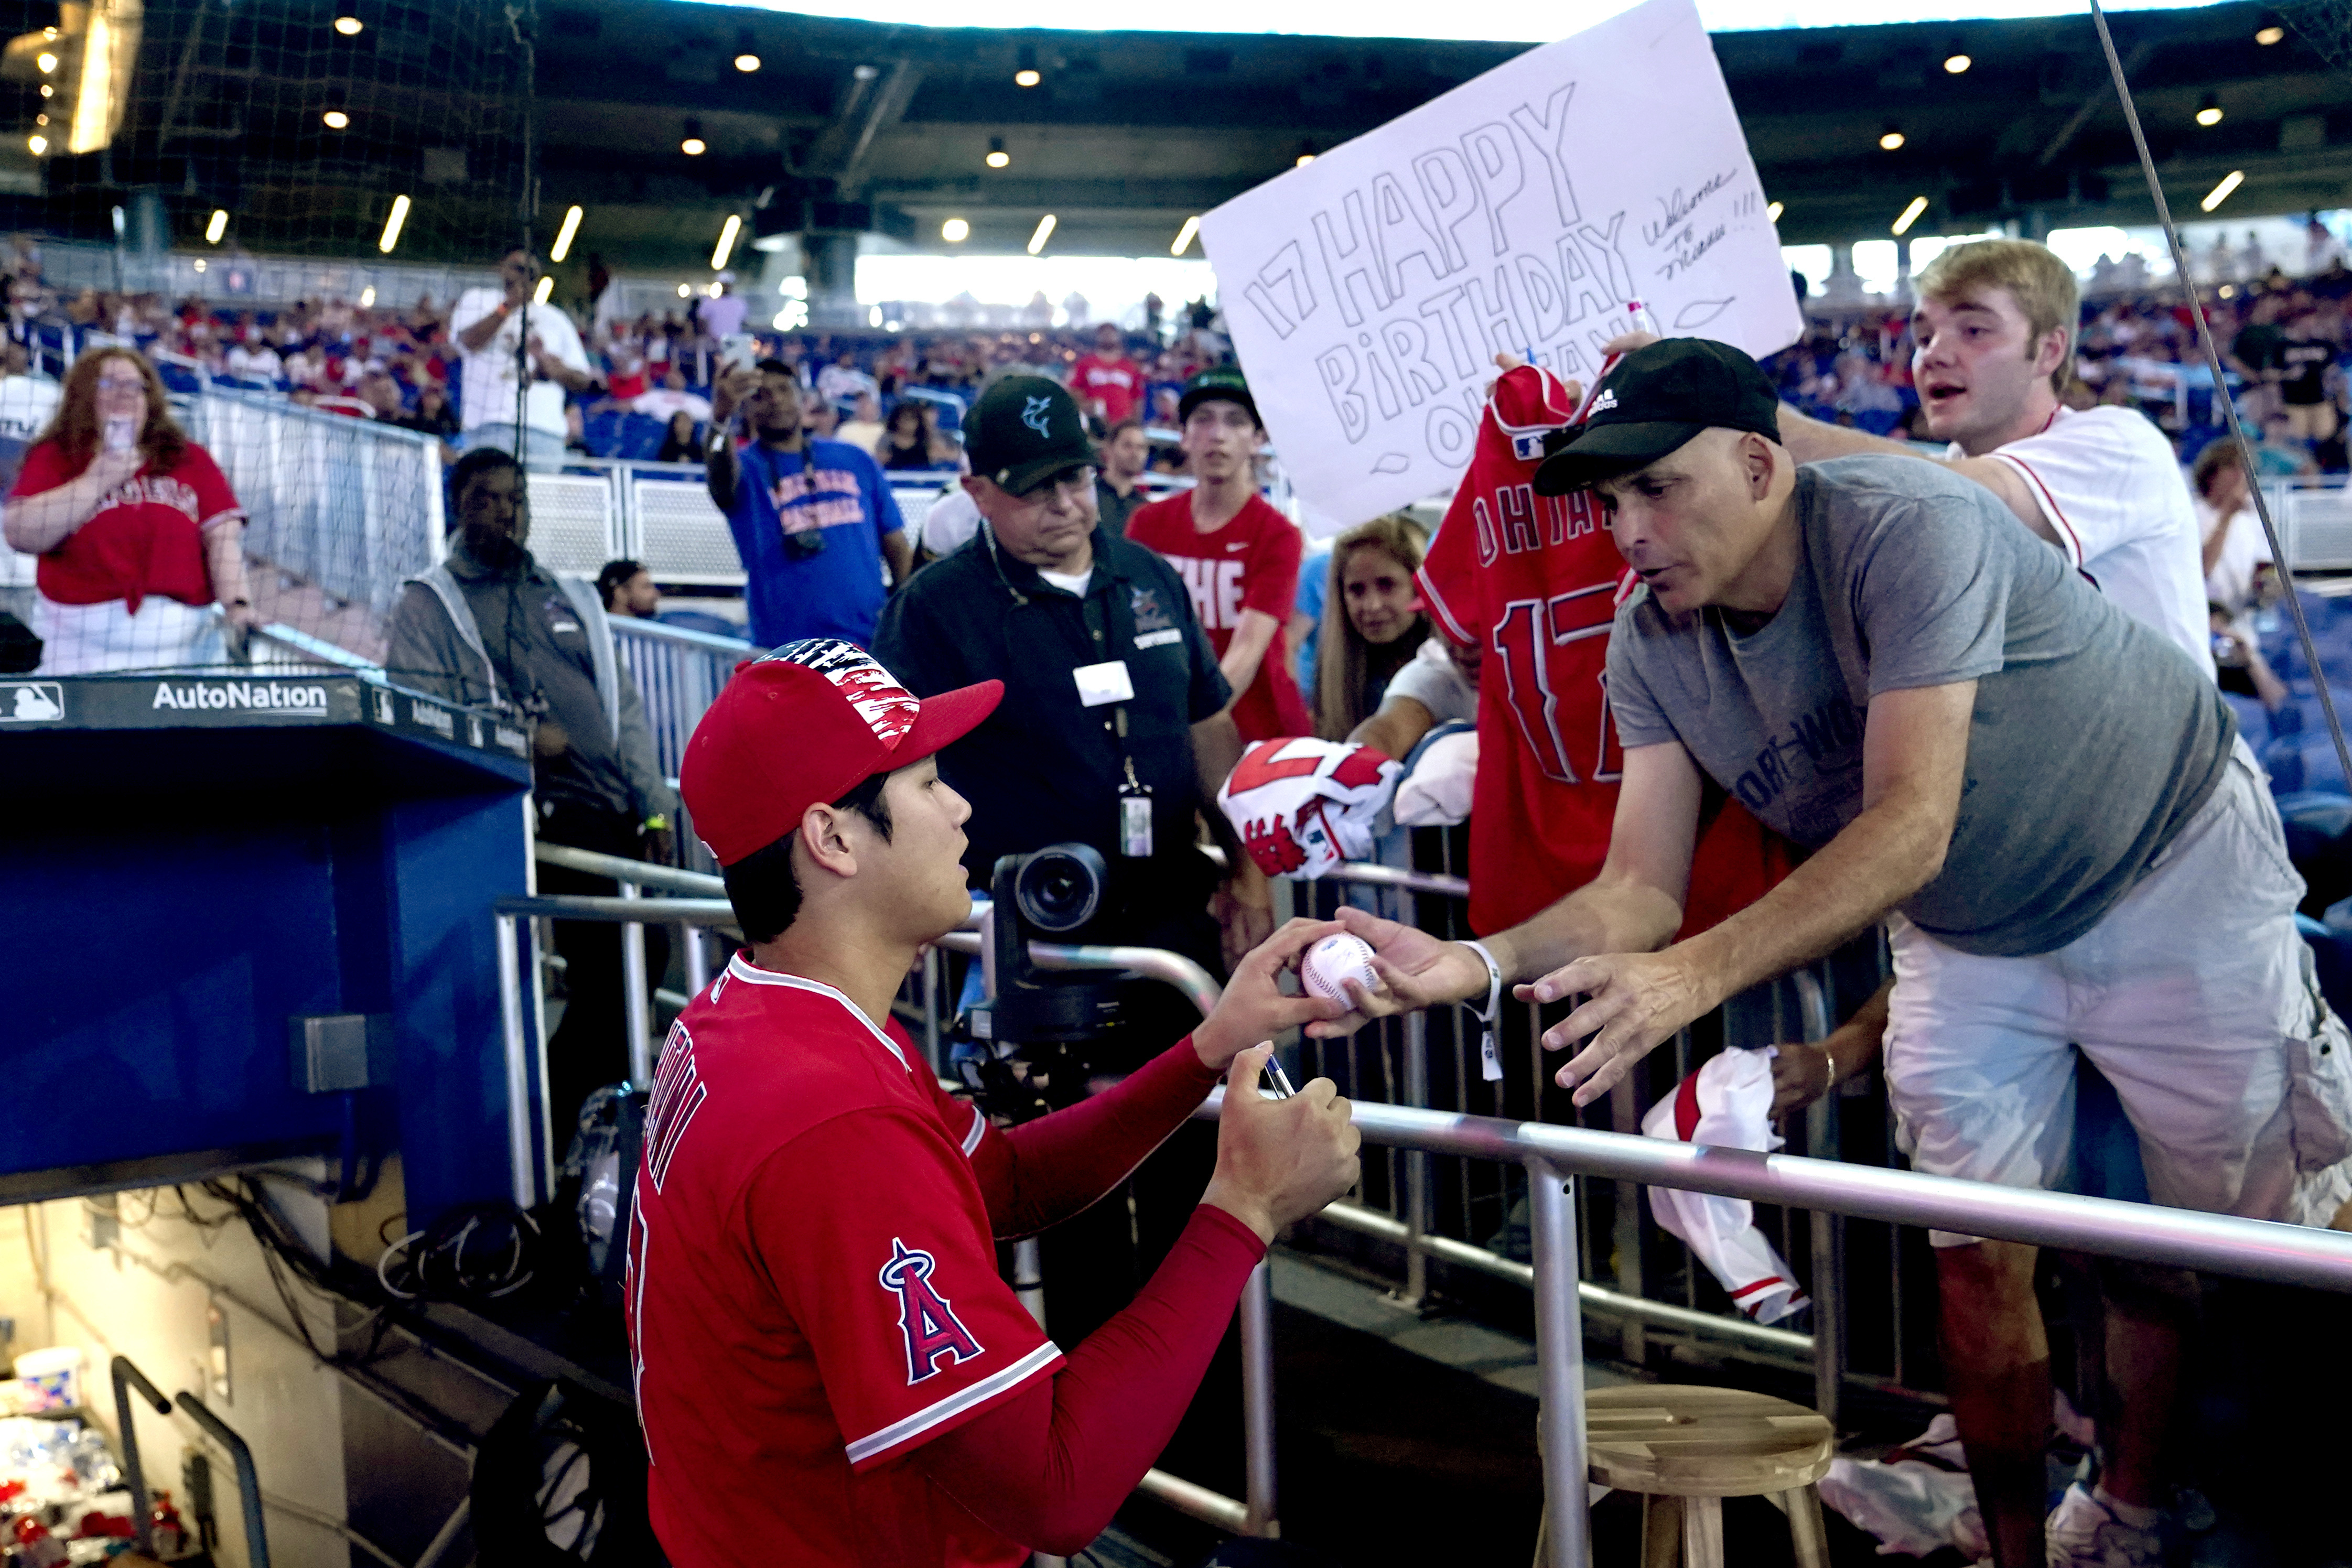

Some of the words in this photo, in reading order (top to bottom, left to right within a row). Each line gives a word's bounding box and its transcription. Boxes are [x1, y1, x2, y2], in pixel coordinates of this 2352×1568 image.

[1245, 241, 1318, 340] 17
[1312, 81, 1577, 327] HAPPY
[152, 682, 327, 711] AutoNation
